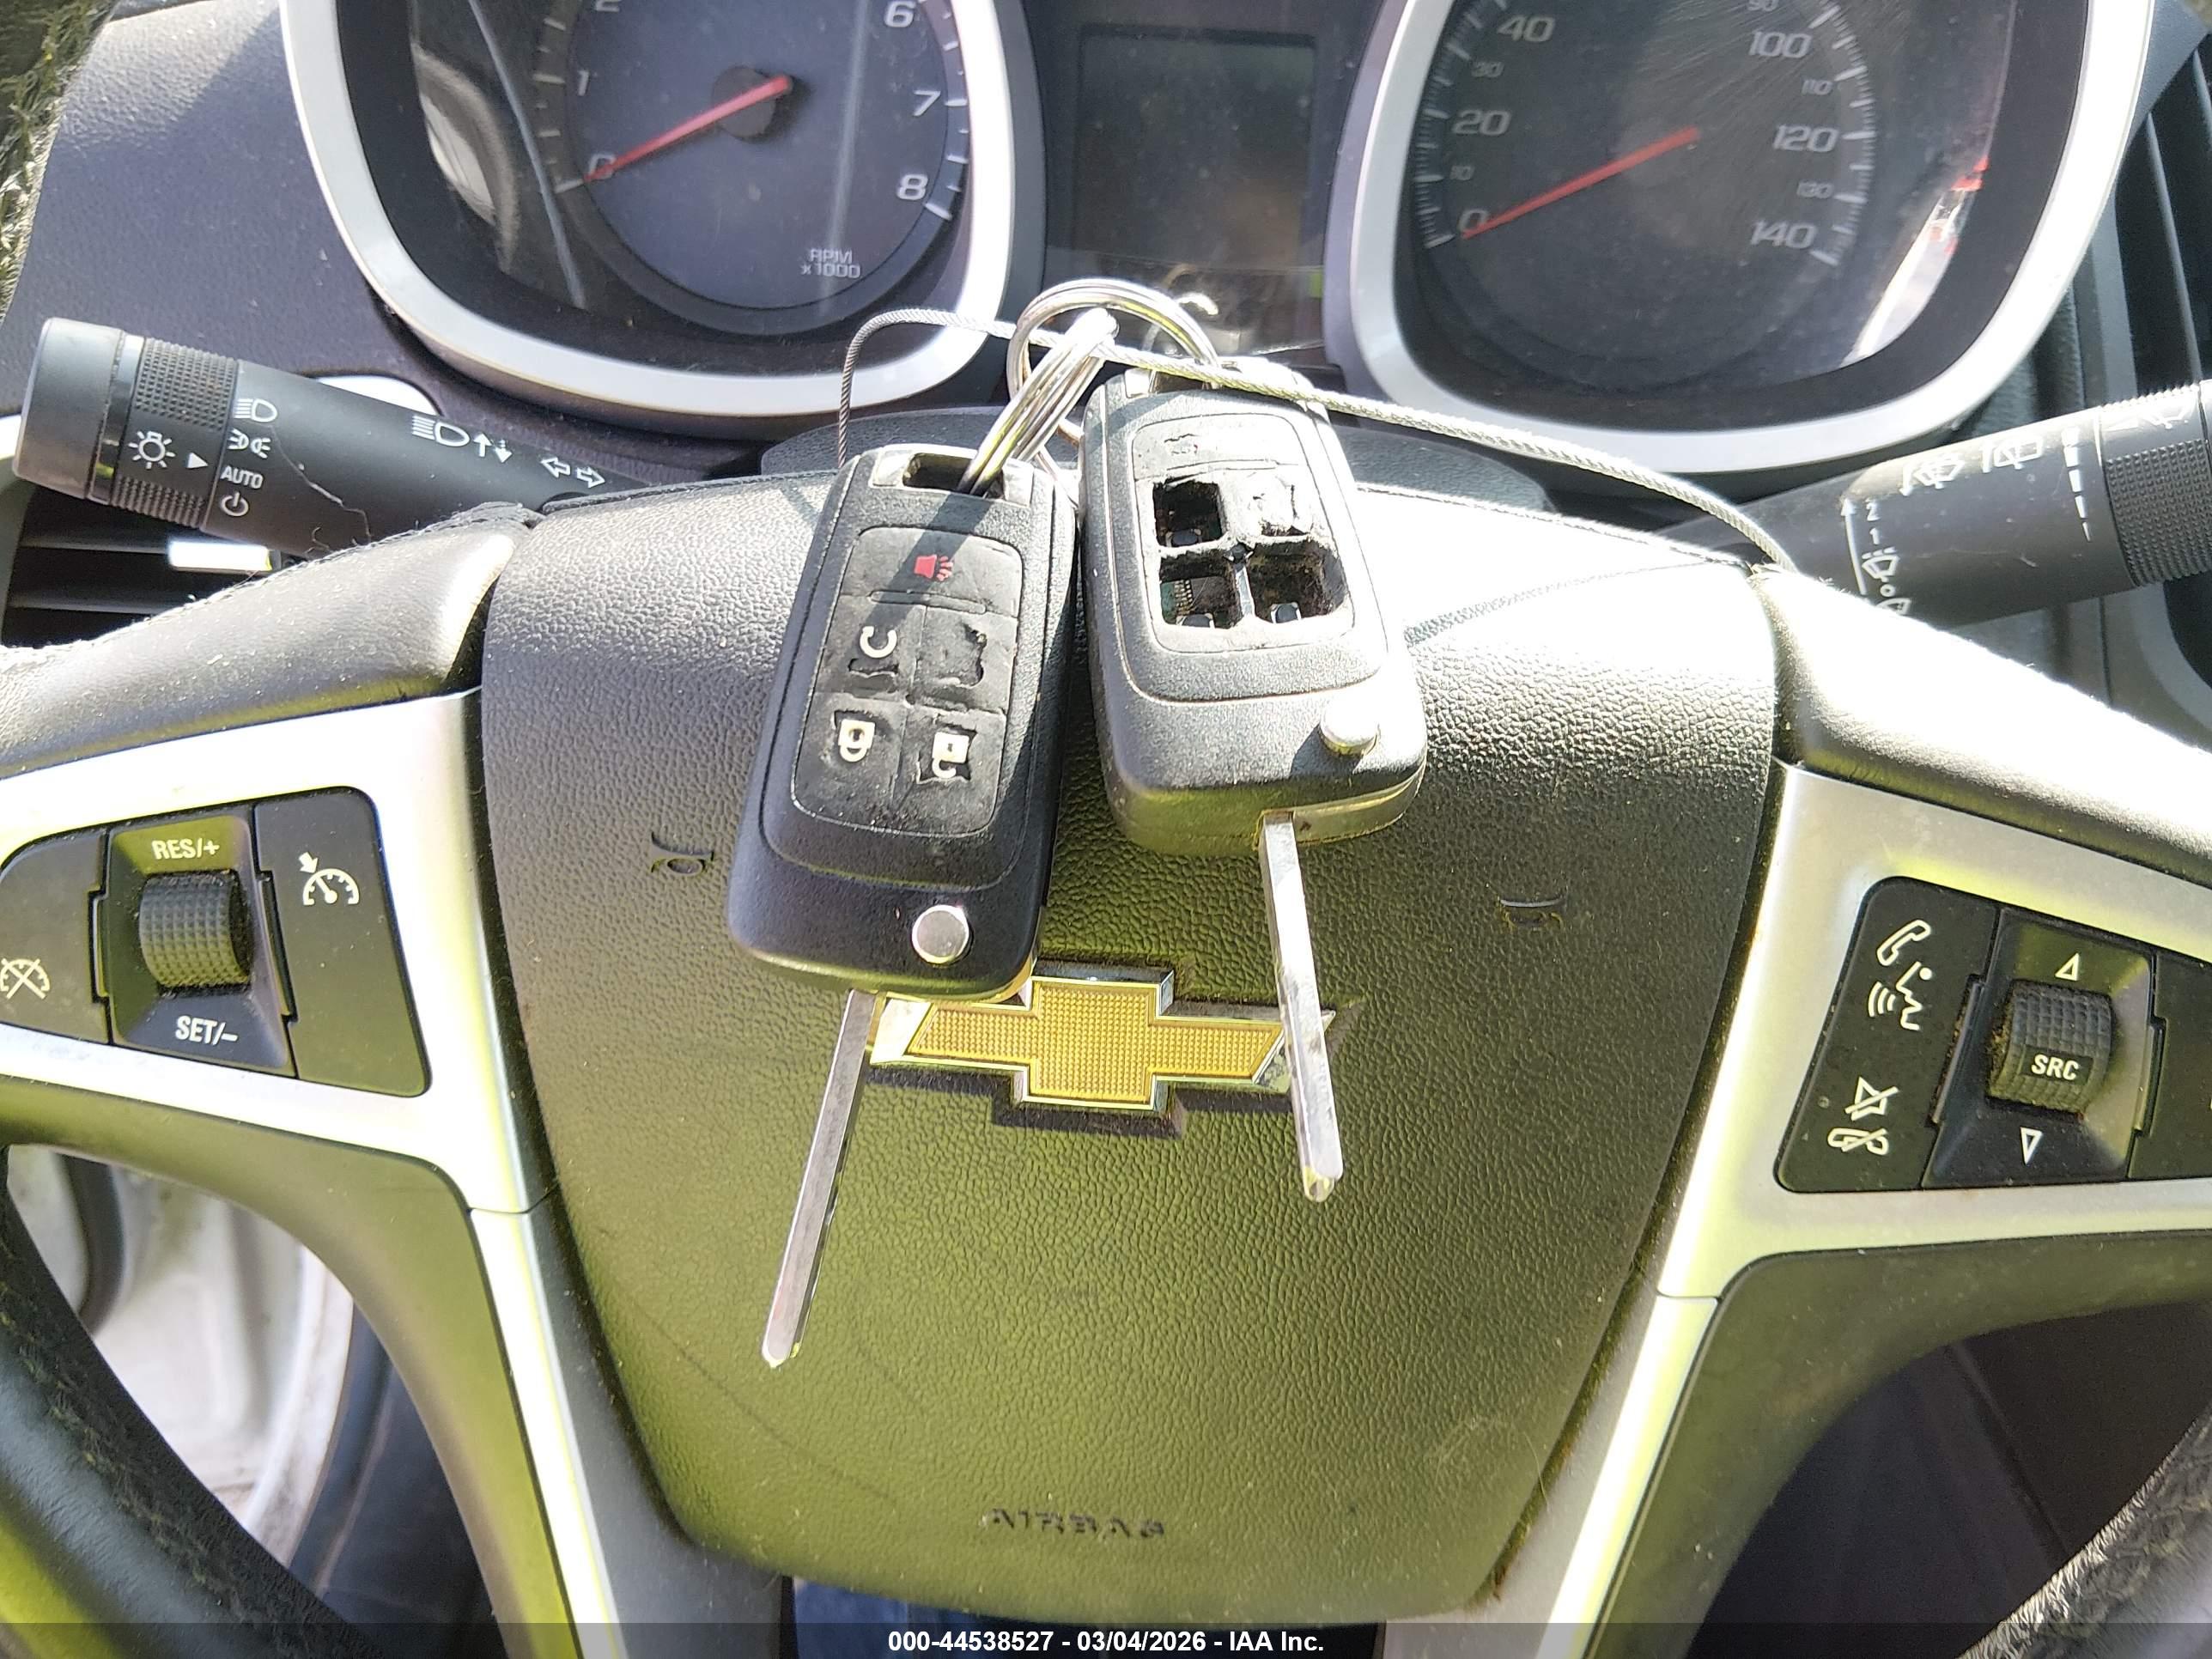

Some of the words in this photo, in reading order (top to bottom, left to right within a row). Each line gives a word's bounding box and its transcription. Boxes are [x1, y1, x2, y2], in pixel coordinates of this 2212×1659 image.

[884, 0, 916, 27] 6
[1497, 15, 1554, 42] 40
[1749, 31, 1812, 58] 100
[578, 70, 589, 96] 1
[913, 90, 940, 116] 7
[1452, 109, 1511, 136] 20
[1773, 125, 1838, 152] 120
[896, 173, 928, 200] 8
[1458, 209, 1491, 234] 0
[1750, 221, 1818, 249] 140
[809, 248, 853, 264] RPM
[220, 465, 264, 489] AUTO
[1865, 501, 1881, 521] 2
[1869, 527, 1880, 544] 1
[151, 837, 220, 860] RES/+
[175, 1015, 239, 1045] SET/-
[2031, 1054, 2079, 1080] SRC
